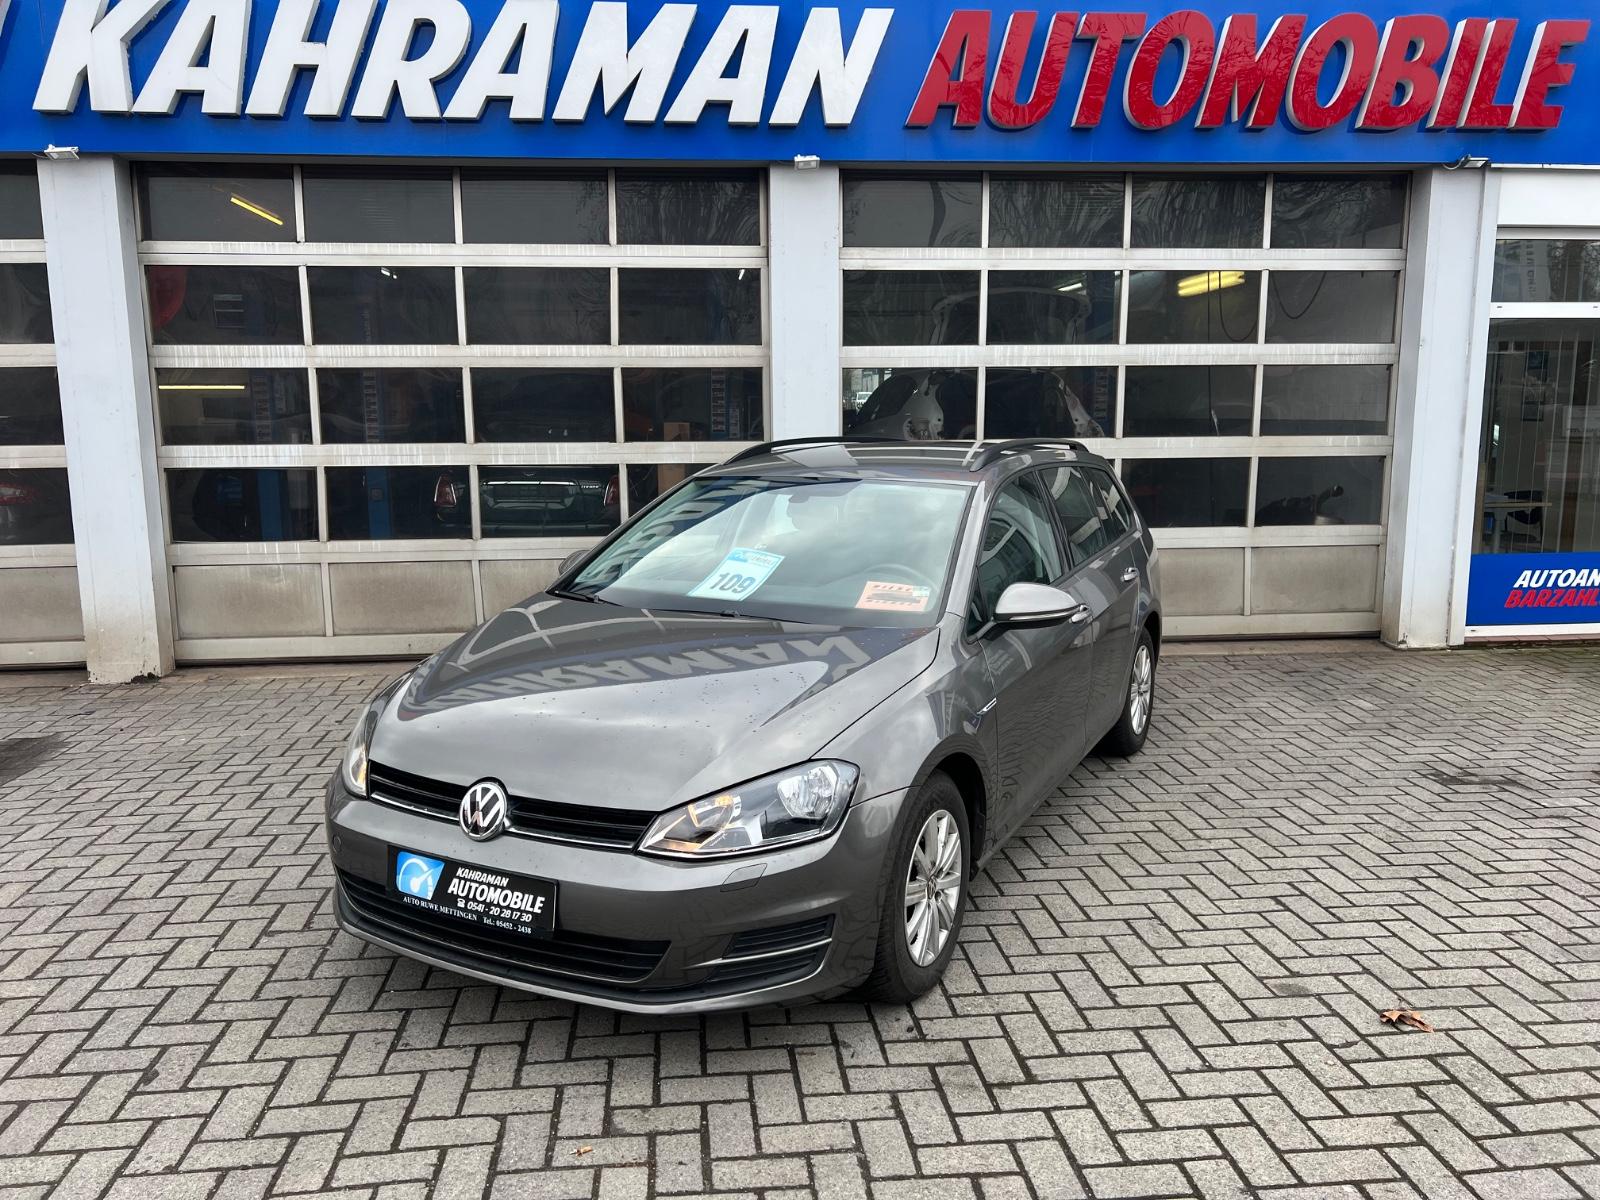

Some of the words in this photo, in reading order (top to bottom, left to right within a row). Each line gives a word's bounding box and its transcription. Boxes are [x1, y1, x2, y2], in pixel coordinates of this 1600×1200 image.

[32, 0, 895, 127] KAHRAMAN
[904, 8, 1590, 132] AUTOMOBILE
[709, 572, 757, 594] 109
[456, 867, 509, 887] KAHRAMAN
[448, 878, 545, 914] AUTOMOBILE
[402, 896, 420, 906] AUTO
[420, 901, 439, 911] RUWE
[440, 905, 478, 921] METTINGEN
[517, 925, 532, 934] 2438
[467, 901, 485, 913] 0541
[489, 906, 500, 916] 20
[500, 909, 511, 918] 28
[512, 911, 520, 920] 17
[520, 913, 532, 922] 30
